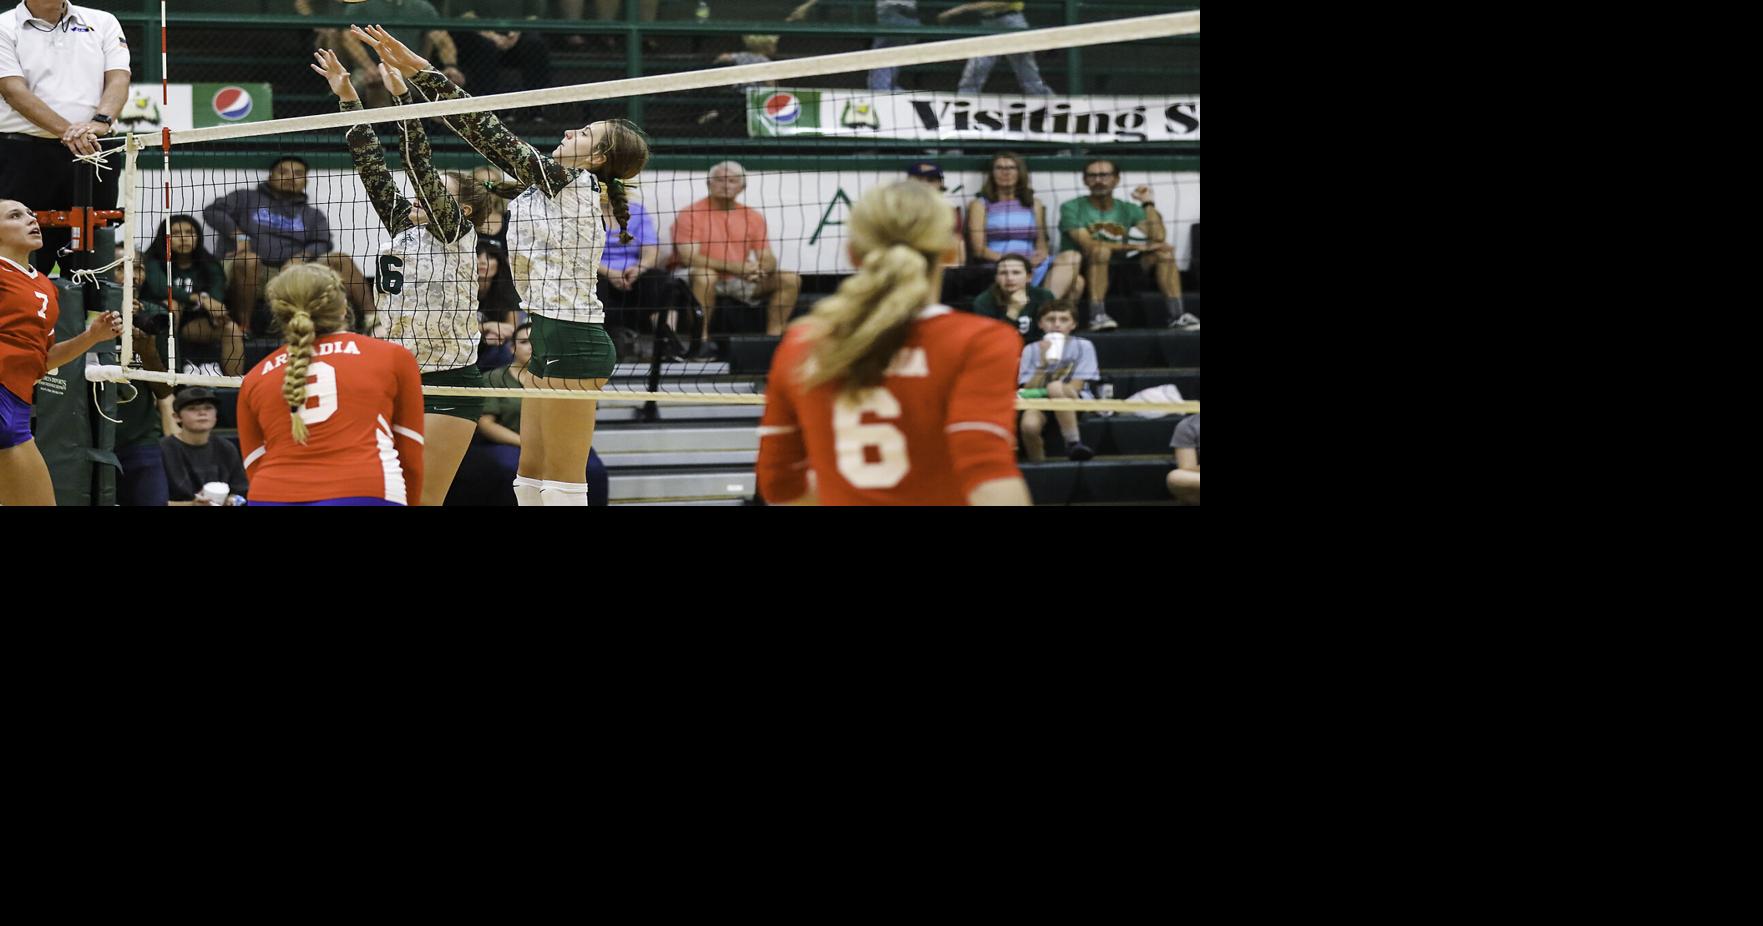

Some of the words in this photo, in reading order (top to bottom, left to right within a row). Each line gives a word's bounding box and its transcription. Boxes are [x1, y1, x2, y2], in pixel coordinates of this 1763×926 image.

[911, 101, 1147, 142] Visiting
[376, 254, 404, 295] 6
[33, 290, 49, 319] 7
[261, 340, 361, 375] ARDIA
[832, 386, 911, 489] 6
